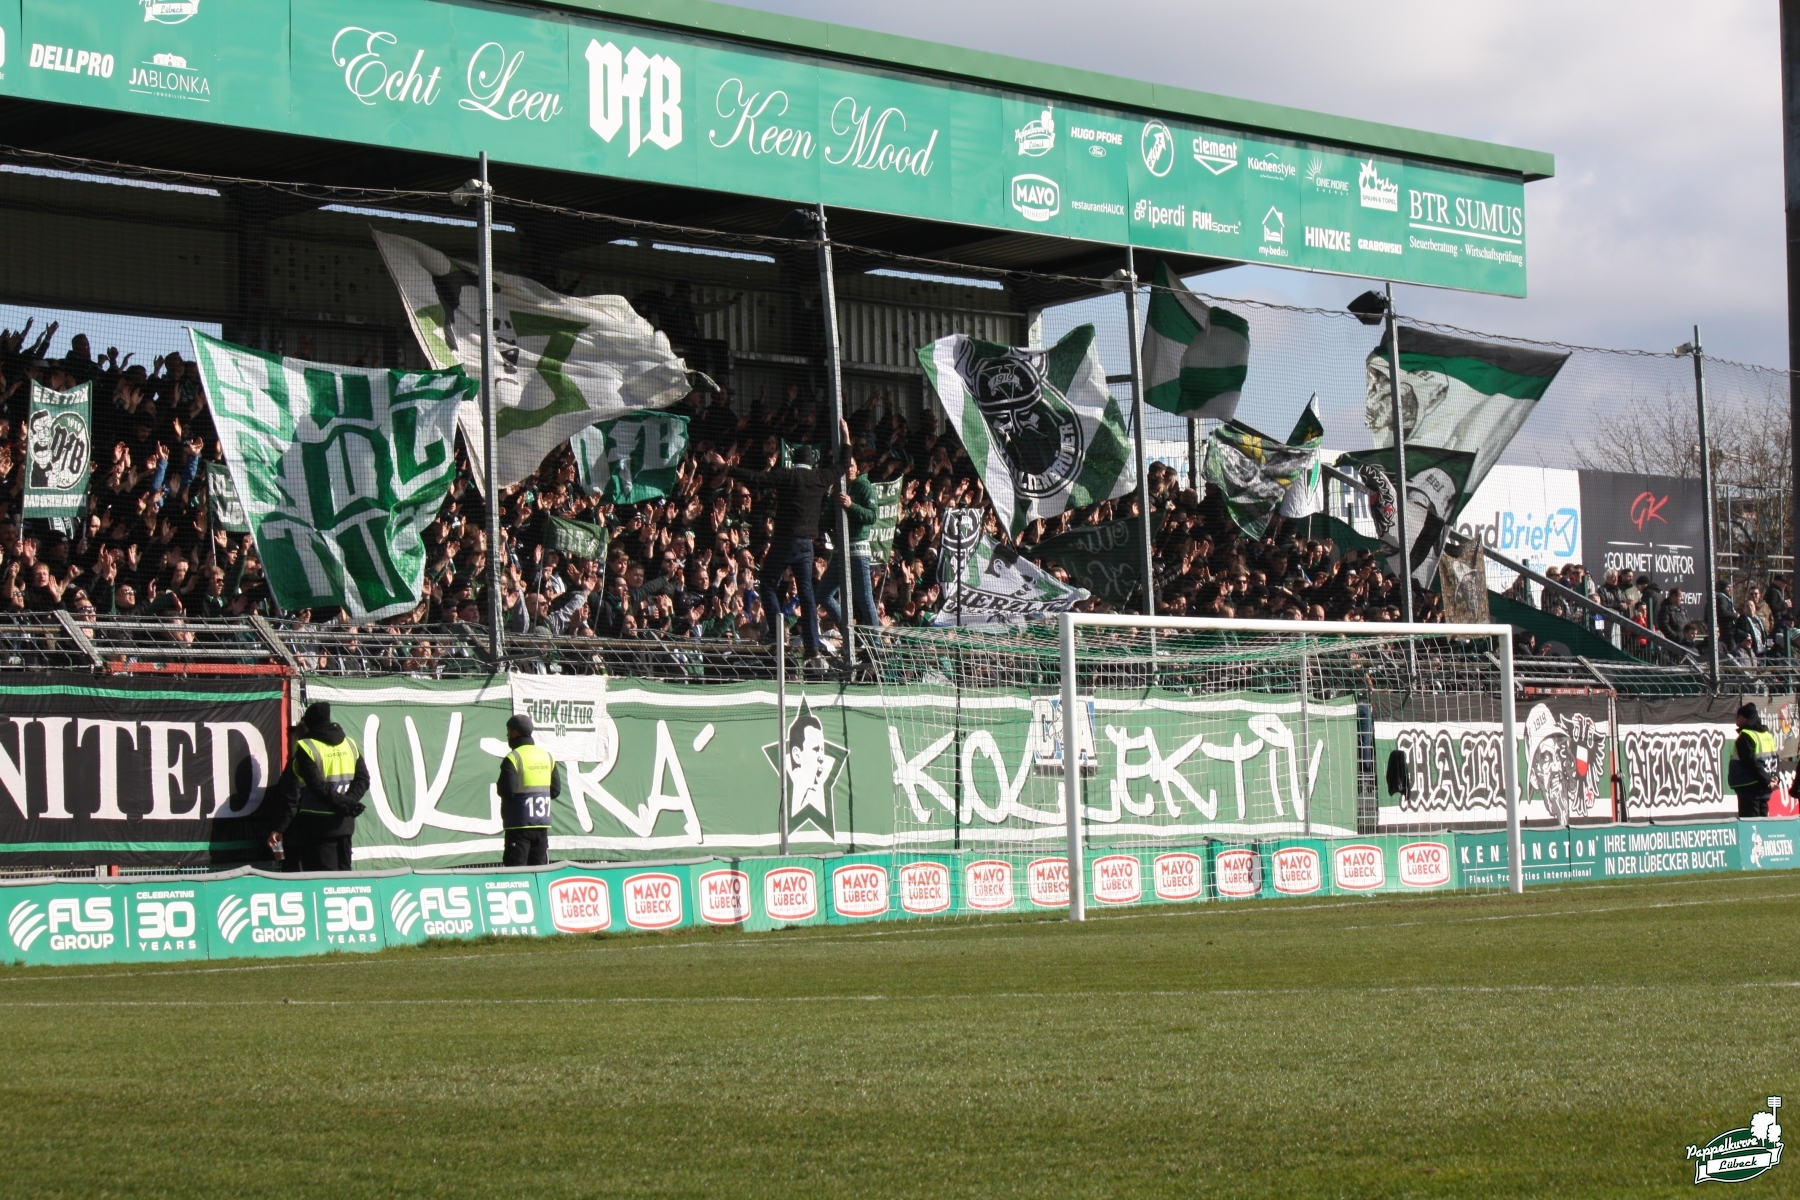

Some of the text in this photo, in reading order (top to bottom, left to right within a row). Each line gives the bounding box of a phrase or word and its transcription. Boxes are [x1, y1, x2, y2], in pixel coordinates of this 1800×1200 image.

[160, 5, 183, 14] Lübeck
[29, 43, 114, 78] DELLPRO
[128, 68, 210, 95] JABLONKA
[332, 26, 563, 122] Echt Leev
[709, 78, 938, 176] Keen Mood
[1070, 126, 1122, 146] HUGO PFOHE
[1193, 136, 1237, 159] clement
[1248, 156, 1296, 177] Küchenstyle
[1316, 177, 1349, 192] ONE MORE
[1016, 182, 1054, 206] MAYO
[1362, 194, 1378, 202] SPAHN
[1024, 208, 1048, 218] FEINKOST
[1072, 200, 1124, 216] restaurantHAUCK
[1148, 200, 1184, 228] iperdi
[1409, 190, 1522, 236] BTR SUMUS
[1305, 226, 1350, 252] HINZKE
[1358, 238, 1402, 255] GRABOWSKI
[1409, 236, 1523, 267] Steuerberatung Wirtschaftsprüfung
[994, 373, 1014, 383] 1919
[1630, 491, 1669, 532] GK
[1608, 552, 1694, 574] GOURMET KONTOR
[1533, 712, 1548, 732] 1919
[1604, 828, 1736, 853] IHRE IMMOBILIENEXPERTEN
[1764, 840, 1793, 856] HOLSTEN
[1343, 852, 1375, 866] MAYO
[1406, 849, 1440, 864] MAYO
[1461, 840, 1596, 864] KENINGTON
[1101, 863, 1132, 878] MAYO
[1161, 862, 1194, 876] MAYO
[1224, 857, 1253, 871] MAYO
[1280, 854, 1312, 870] MAYO
[1605, 850, 1728, 875] IN DER LÜBECKER BUCHT.
[842, 872, 878, 890] MAYO
[908, 870, 941, 886] MAYO
[974, 868, 1004, 884] MAYO
[1036, 866, 1069, 881] MAYO
[1469, 874, 1494, 884] Finest
[1544, 868, 1592, 880] International
[323, 886, 372, 895] CELEBRATING
[485, 881, 530, 889] CELEBRATING
[633, 882, 672, 900] MAYO
[708, 878, 741, 895] MAYO
[773, 876, 808, 892] MAYO
[136, 890, 194, 900] CELEBRATING
[420, 886, 472, 920] FLS
[559, 886, 598, 904] MAYO
[48, 896, 114, 933] FLS
[250, 892, 305, 926] FLS
[324, 896, 374, 932] 30
[486, 890, 534, 925] 30
[137, 901, 196, 938] 30
[424, 920, 474, 934] GROUP
[252, 927, 306, 943] GROUP
[328, 933, 377, 944] YEARS
[492, 926, 537, 936] YEARS
[50, 934, 114, 950] GROUP
[139, 940, 196, 951] YEARS
